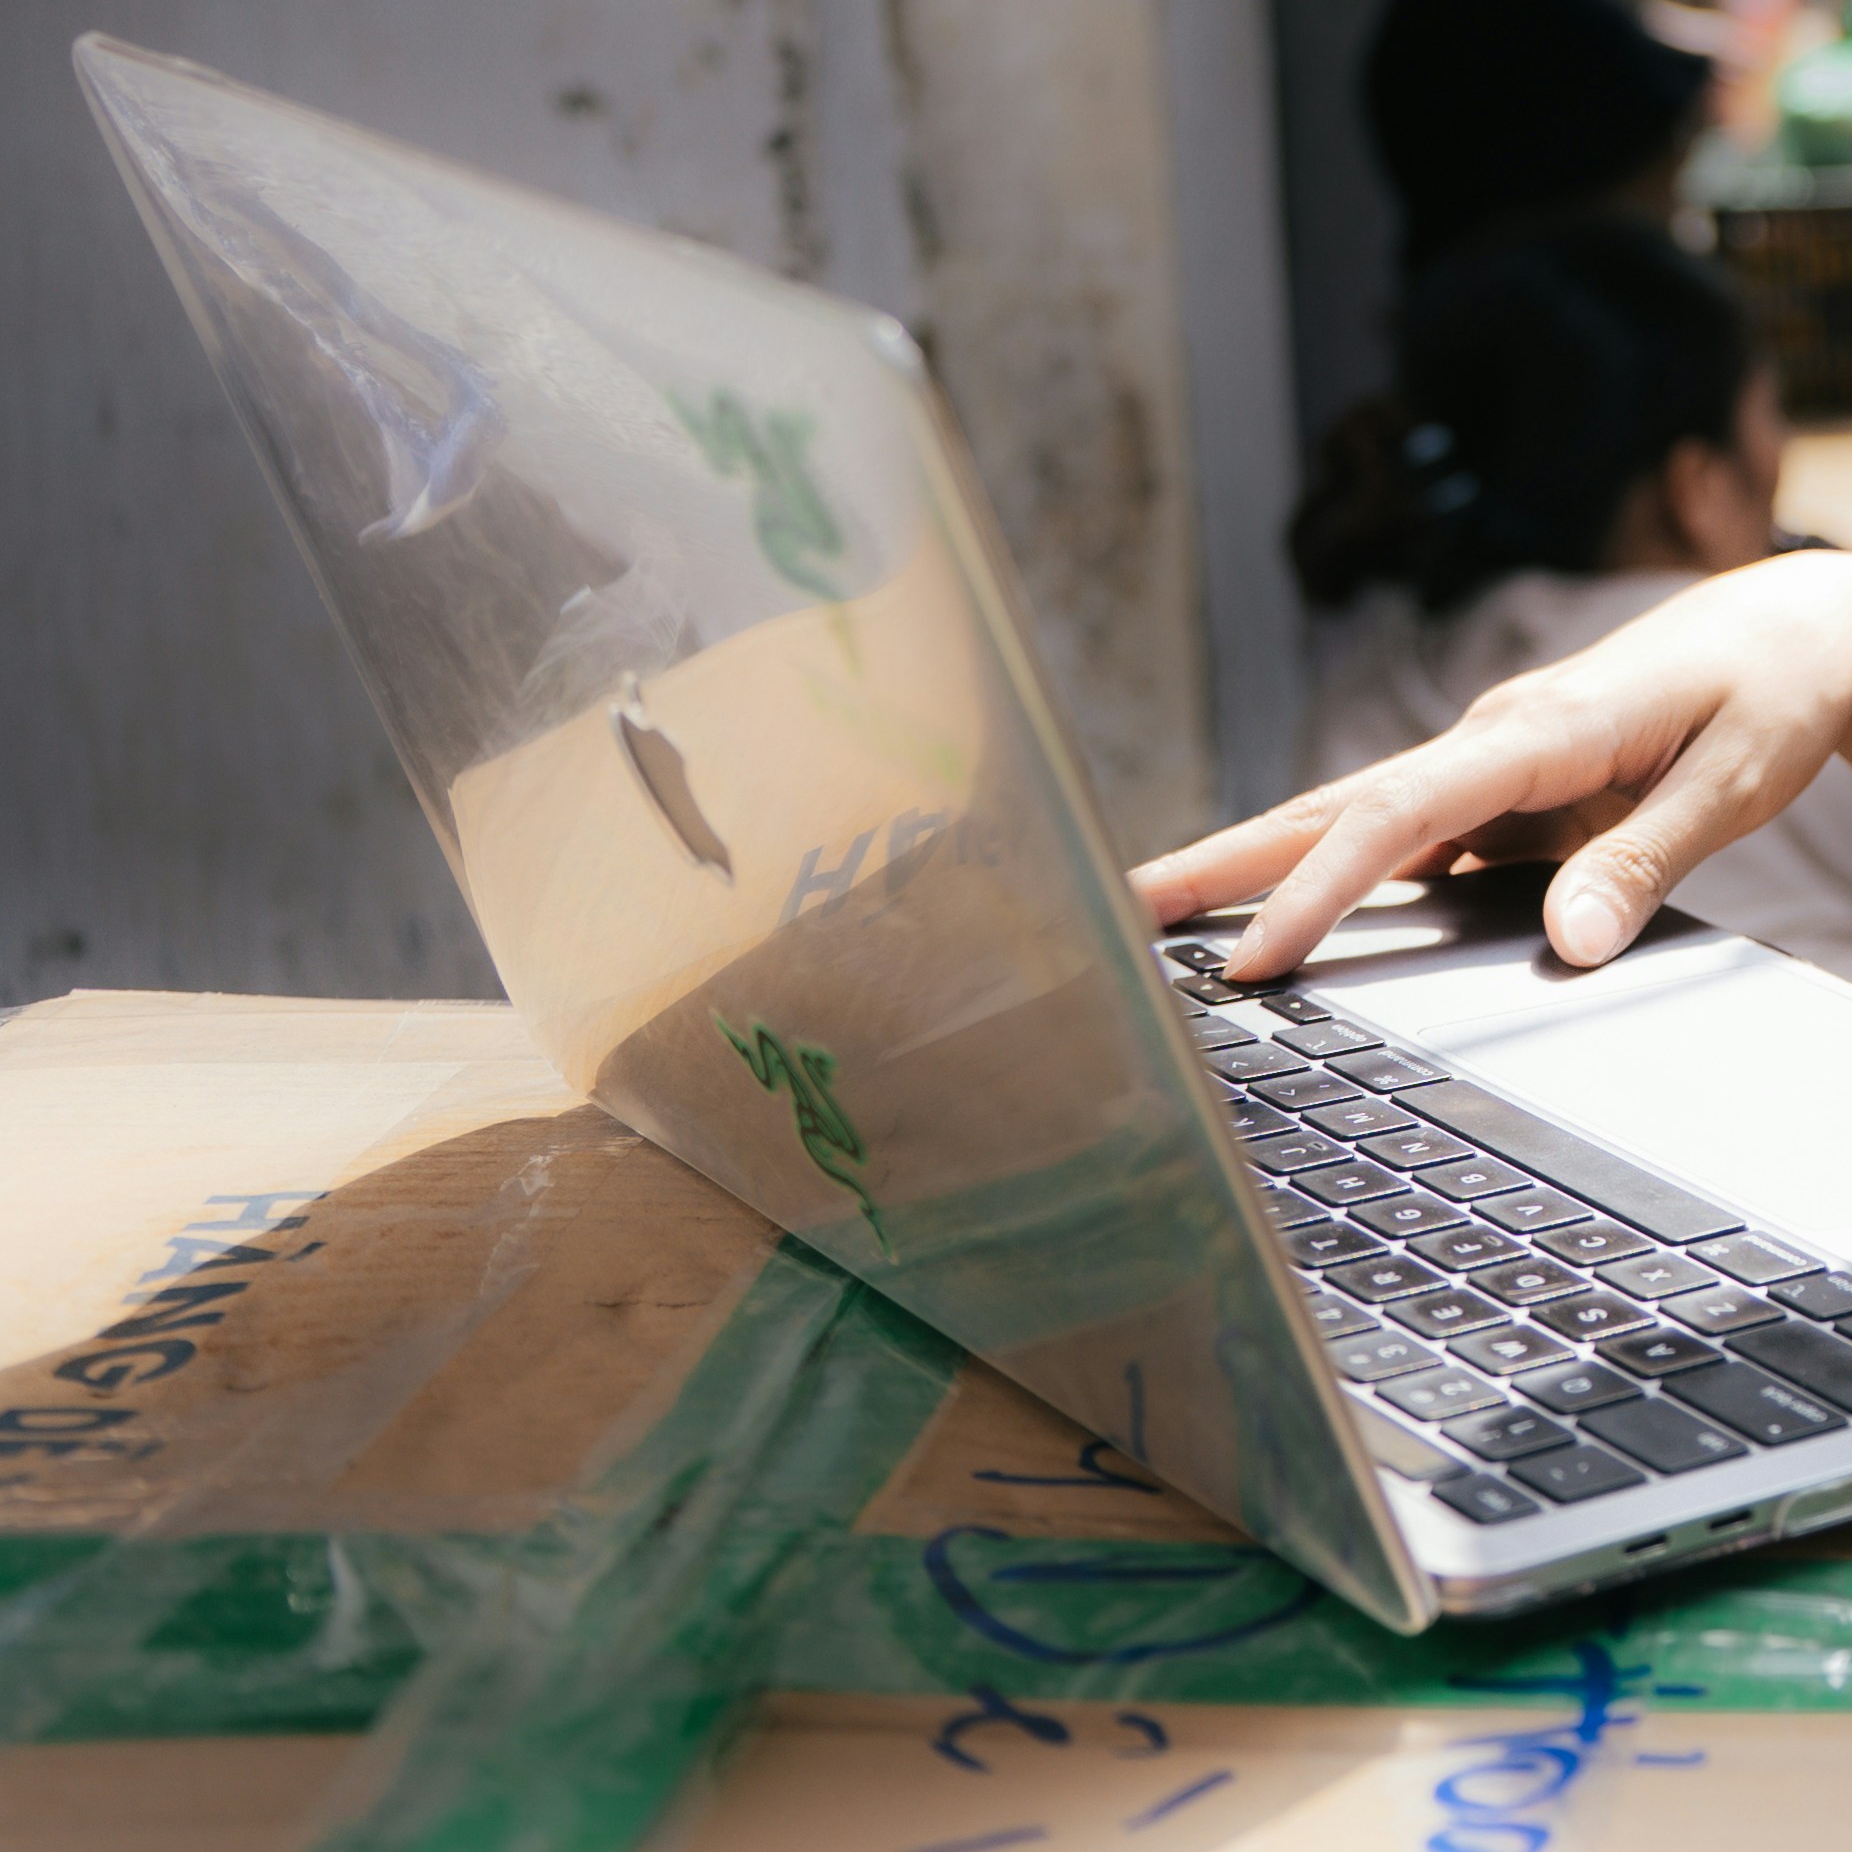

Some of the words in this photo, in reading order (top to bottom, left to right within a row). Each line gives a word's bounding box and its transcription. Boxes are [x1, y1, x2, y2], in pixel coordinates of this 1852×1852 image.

[1330, 1023, 1368, 1043] option
[1377, 1050, 1435, 1077] command
[1344, 1113, 1375, 1125] M
[1280, 1147, 1307, 1157] J
[1401, 1142, 1430, 1155] N
[1336, 1175, 1366, 1190] H
[1461, 1173, 1487, 1185] B
[1395, 1208, 1422, 1221] G
[1516, 1204, 1543, 1217] V
[1453, 1242, 1482, 1255] F
[1578, 1235, 1607, 1249] C
[1372, 1270, 1402, 1286] R
[1516, 1274, 1546, 1289] D
[1640, 1268, 1672, 1283] X
[1431, 1304, 1464, 1321] E
[1578, 1307, 1608, 1323] S
[1703, 1300, 1737, 1317] Z
[1491, 1340, 1528, 1359] W
[1646, 1343, 1676, 1359] A
